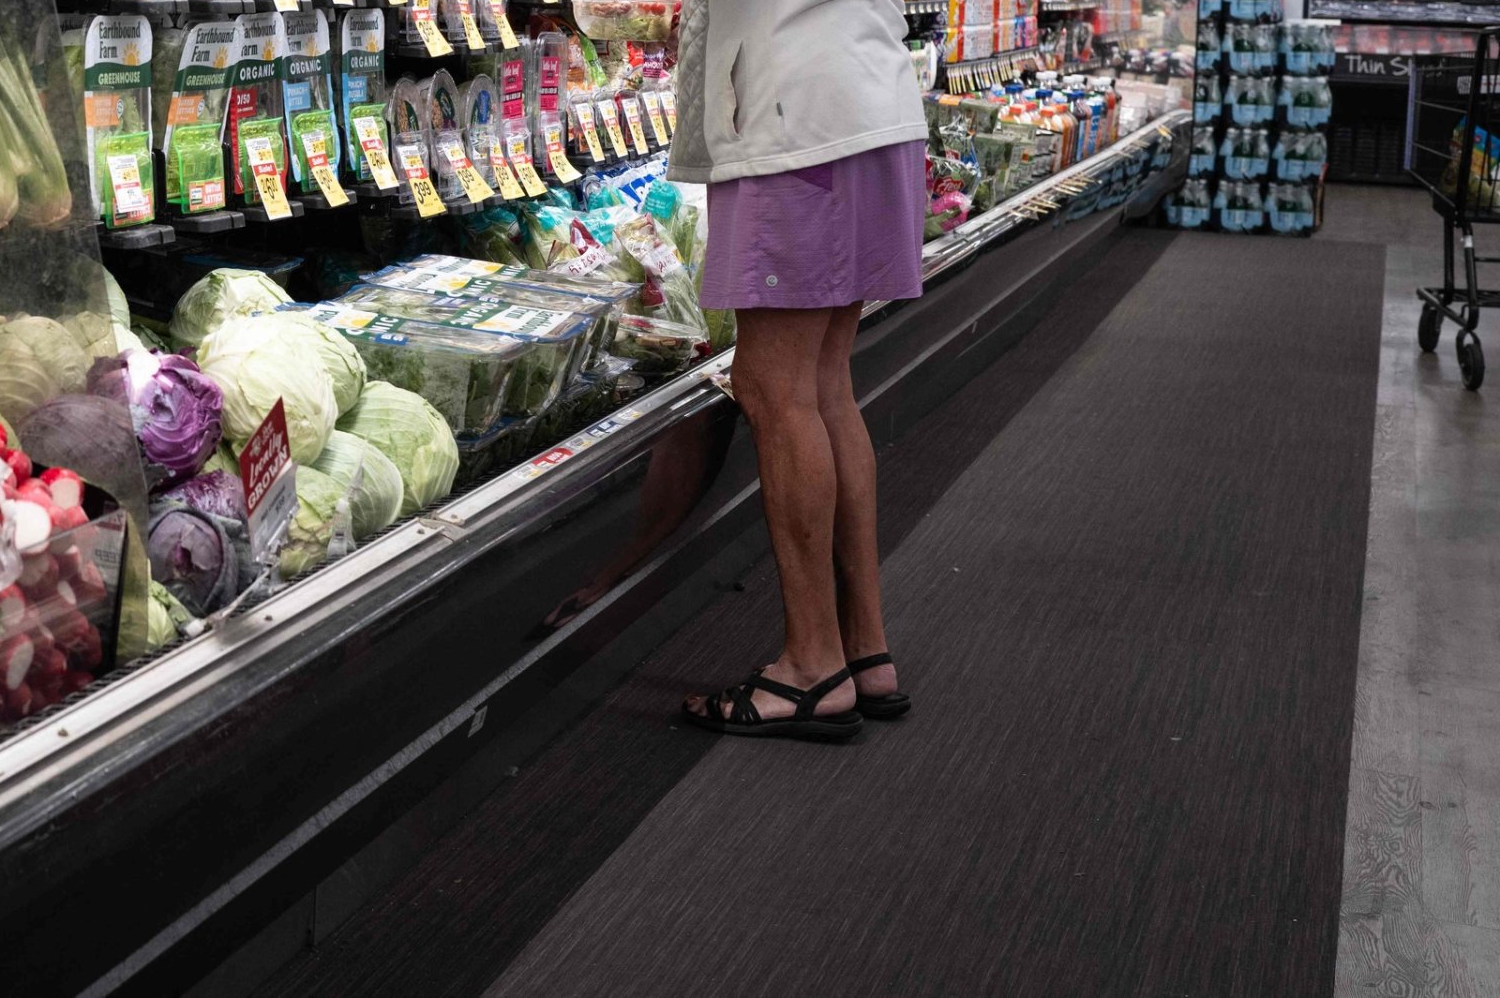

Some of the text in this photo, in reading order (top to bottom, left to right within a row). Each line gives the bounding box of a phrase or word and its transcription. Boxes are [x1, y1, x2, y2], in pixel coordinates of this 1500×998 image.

[99, 21, 141, 40] Earthbound
[243, 19, 277, 38] arthbound
[286, 18, 319, 34] Earthbound
[351, 16, 379, 30] Earthbound
[195, 28, 235, 44] Earthbound
[99, 41, 118, 59] Farm
[191, 45, 211, 62] Farm
[290, 59, 322, 75] ORGANIC
[351, 55, 380, 68] ORGANIC
[1345, 55, 1386, 75] Thin
[98, 71, 141, 85] GREENHOUSE
[186, 72, 226, 87] GREENHOUSE
[239, 64, 275, 81] ORGANIC
[413, 180, 432, 203] 399
[248, 444, 288, 510] GROWN
